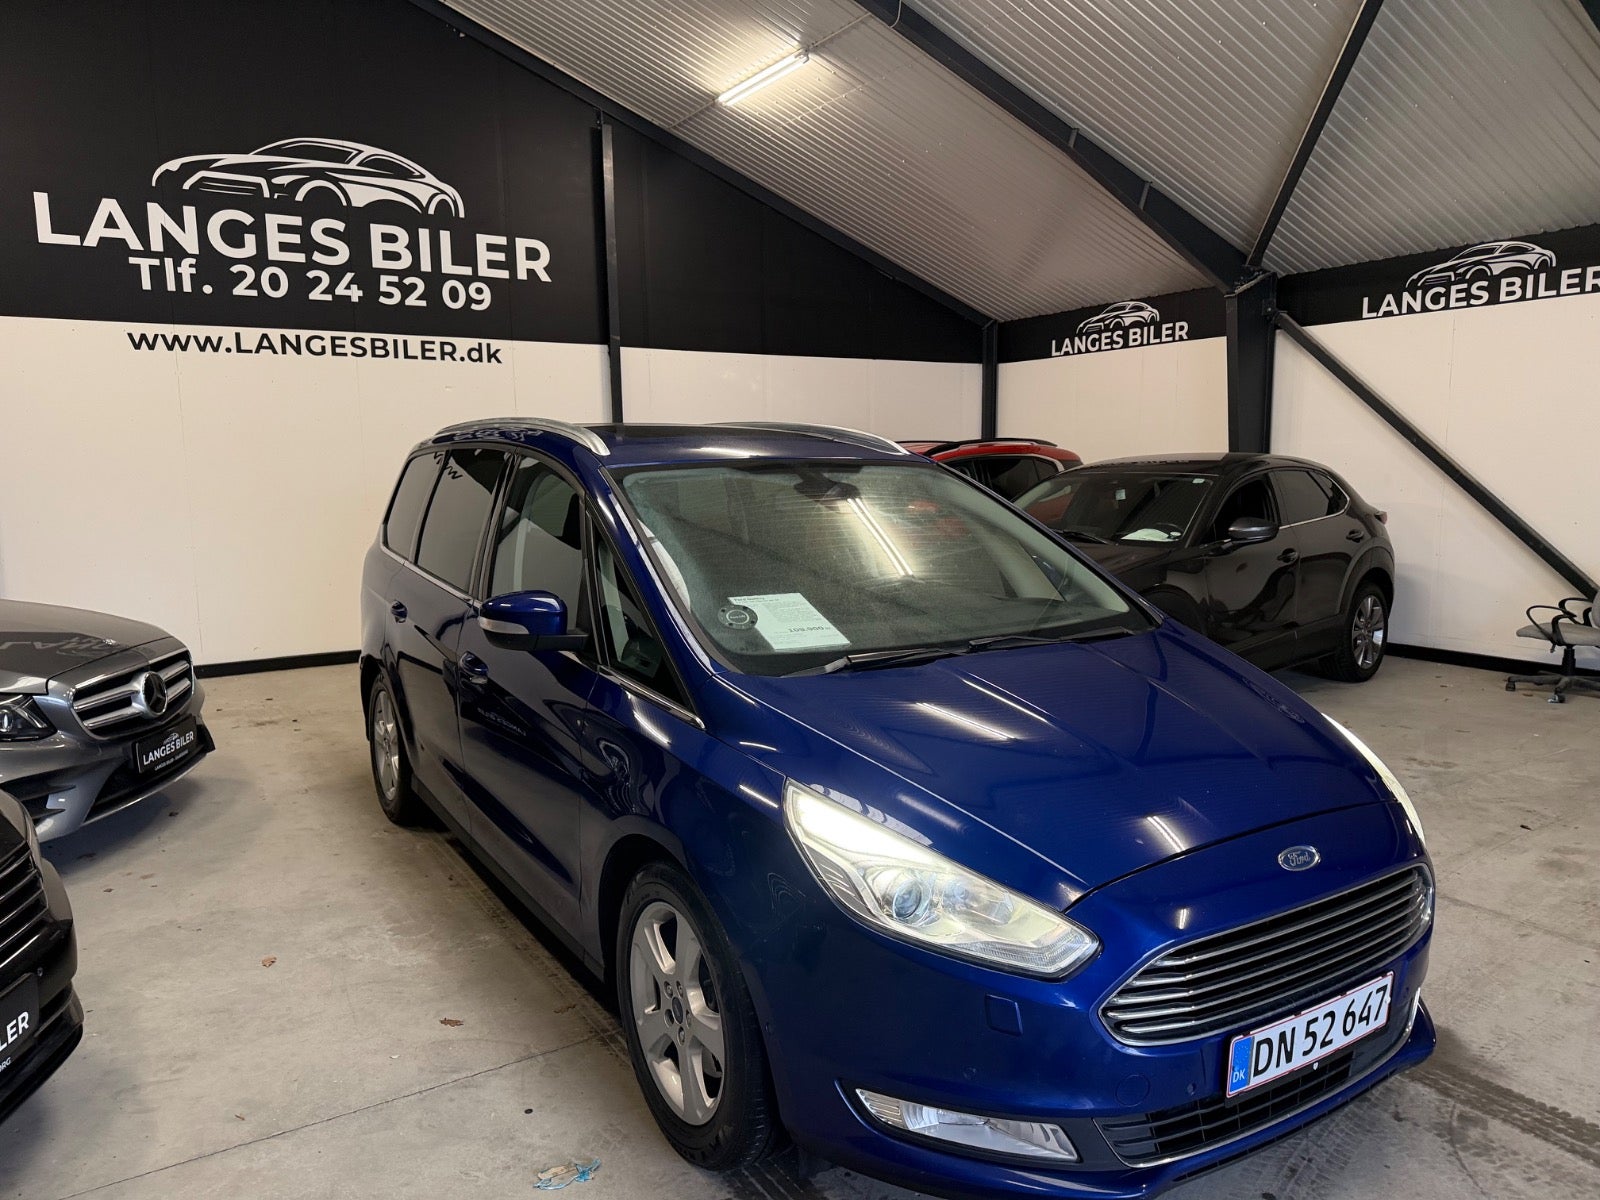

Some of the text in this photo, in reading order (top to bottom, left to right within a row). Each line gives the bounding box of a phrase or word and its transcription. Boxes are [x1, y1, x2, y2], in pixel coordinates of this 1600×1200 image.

[33, 191, 553, 283] LANGES BILER
[128, 256, 492, 311] Tlf. 20 24 52 09
[1362, 281, 1489, 319] LANGES
[127, 331, 503, 364] www.LANGESBILER.dk
[1051, 321, 1189, 357] LANGES BILER
[143, 741, 175, 766] LANGES
[176, 730, 194, 749] BILER
[1252, 984, 1389, 1078] DN 52 647
[1232, 1068, 1246, 1083] DK
